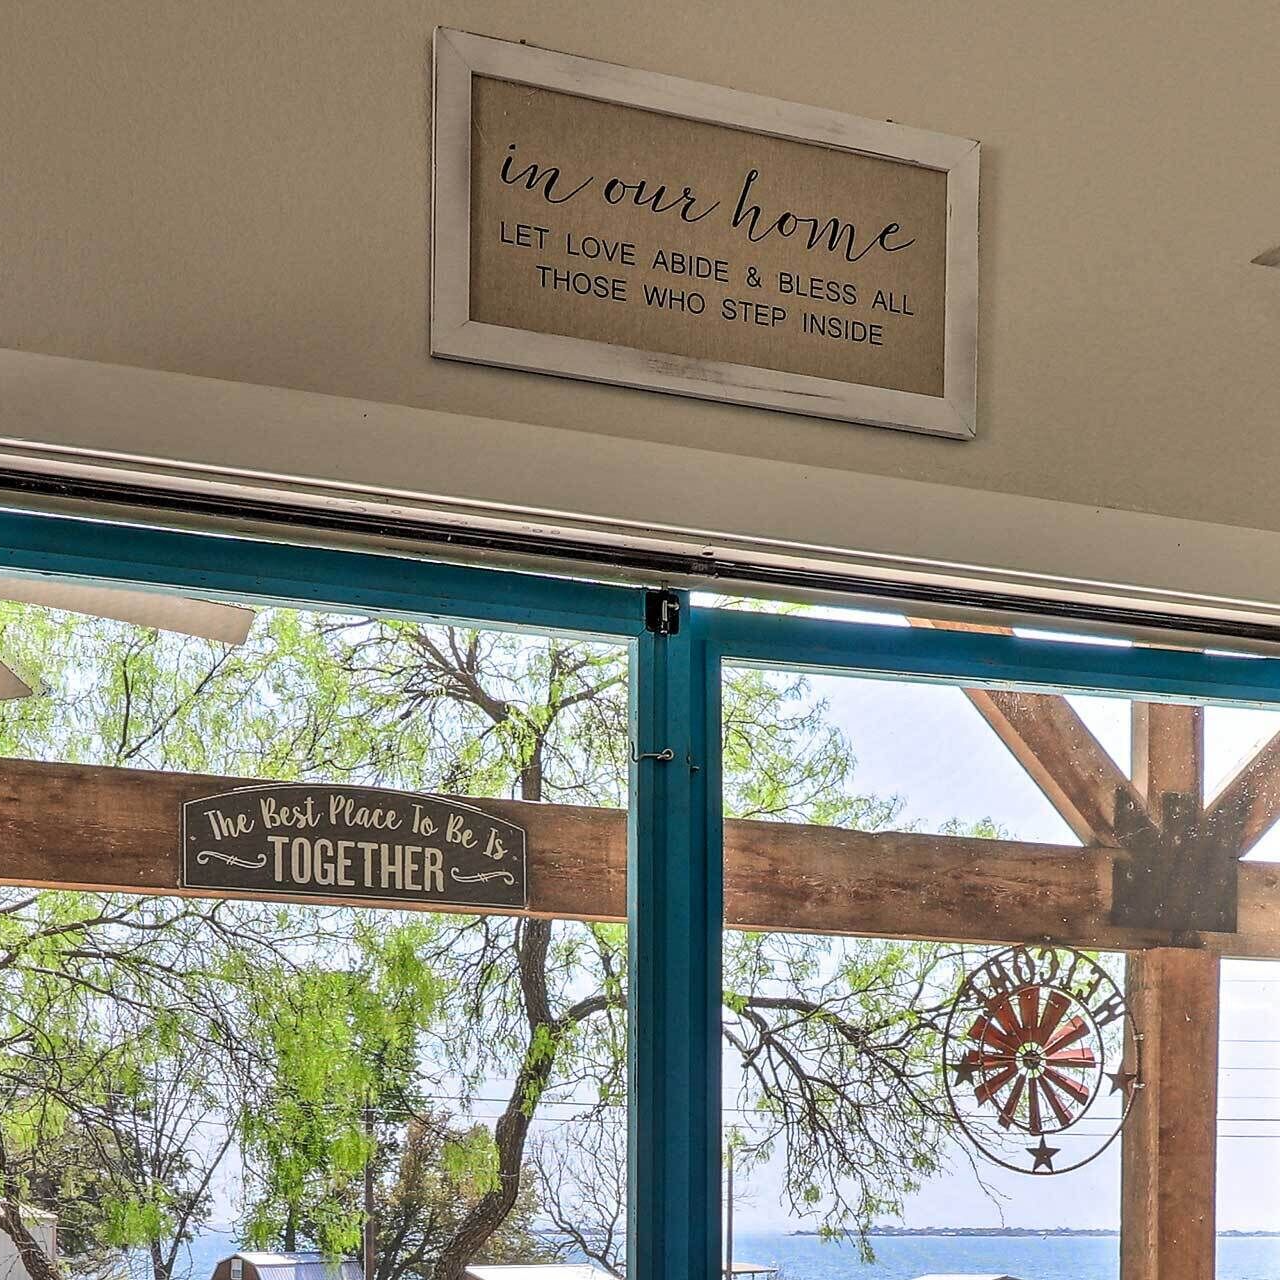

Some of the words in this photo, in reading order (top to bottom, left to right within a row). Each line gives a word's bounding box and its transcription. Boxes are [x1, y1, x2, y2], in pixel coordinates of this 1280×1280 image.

[500, 143, 594, 204] in
[603, 174, 721, 223] our
[731, 169, 916, 263] home
[500, 220, 550, 250] LET
[566, 233, 636, 266] LOVE
[651, 249, 729, 283] ABIDE
[746, 266, 763, 288] &
[779, 271, 857, 306] BLESS
[871, 288, 915, 316] ALL
[535, 265, 627, 302] THOSE
[643, 283, 706, 315] WHO
[721, 298, 787, 328] STEP
[803, 312, 884, 346] INSIDE
[203, 809, 255, 841] The
[259, 795, 321, 829] Best
[328, 794, 404, 831] Place
[411, 803, 439, 837] To
[445, 813, 478, 849] Be
[482, 827, 509, 860] Is
[267, 835, 445, 892] TOGETHER
